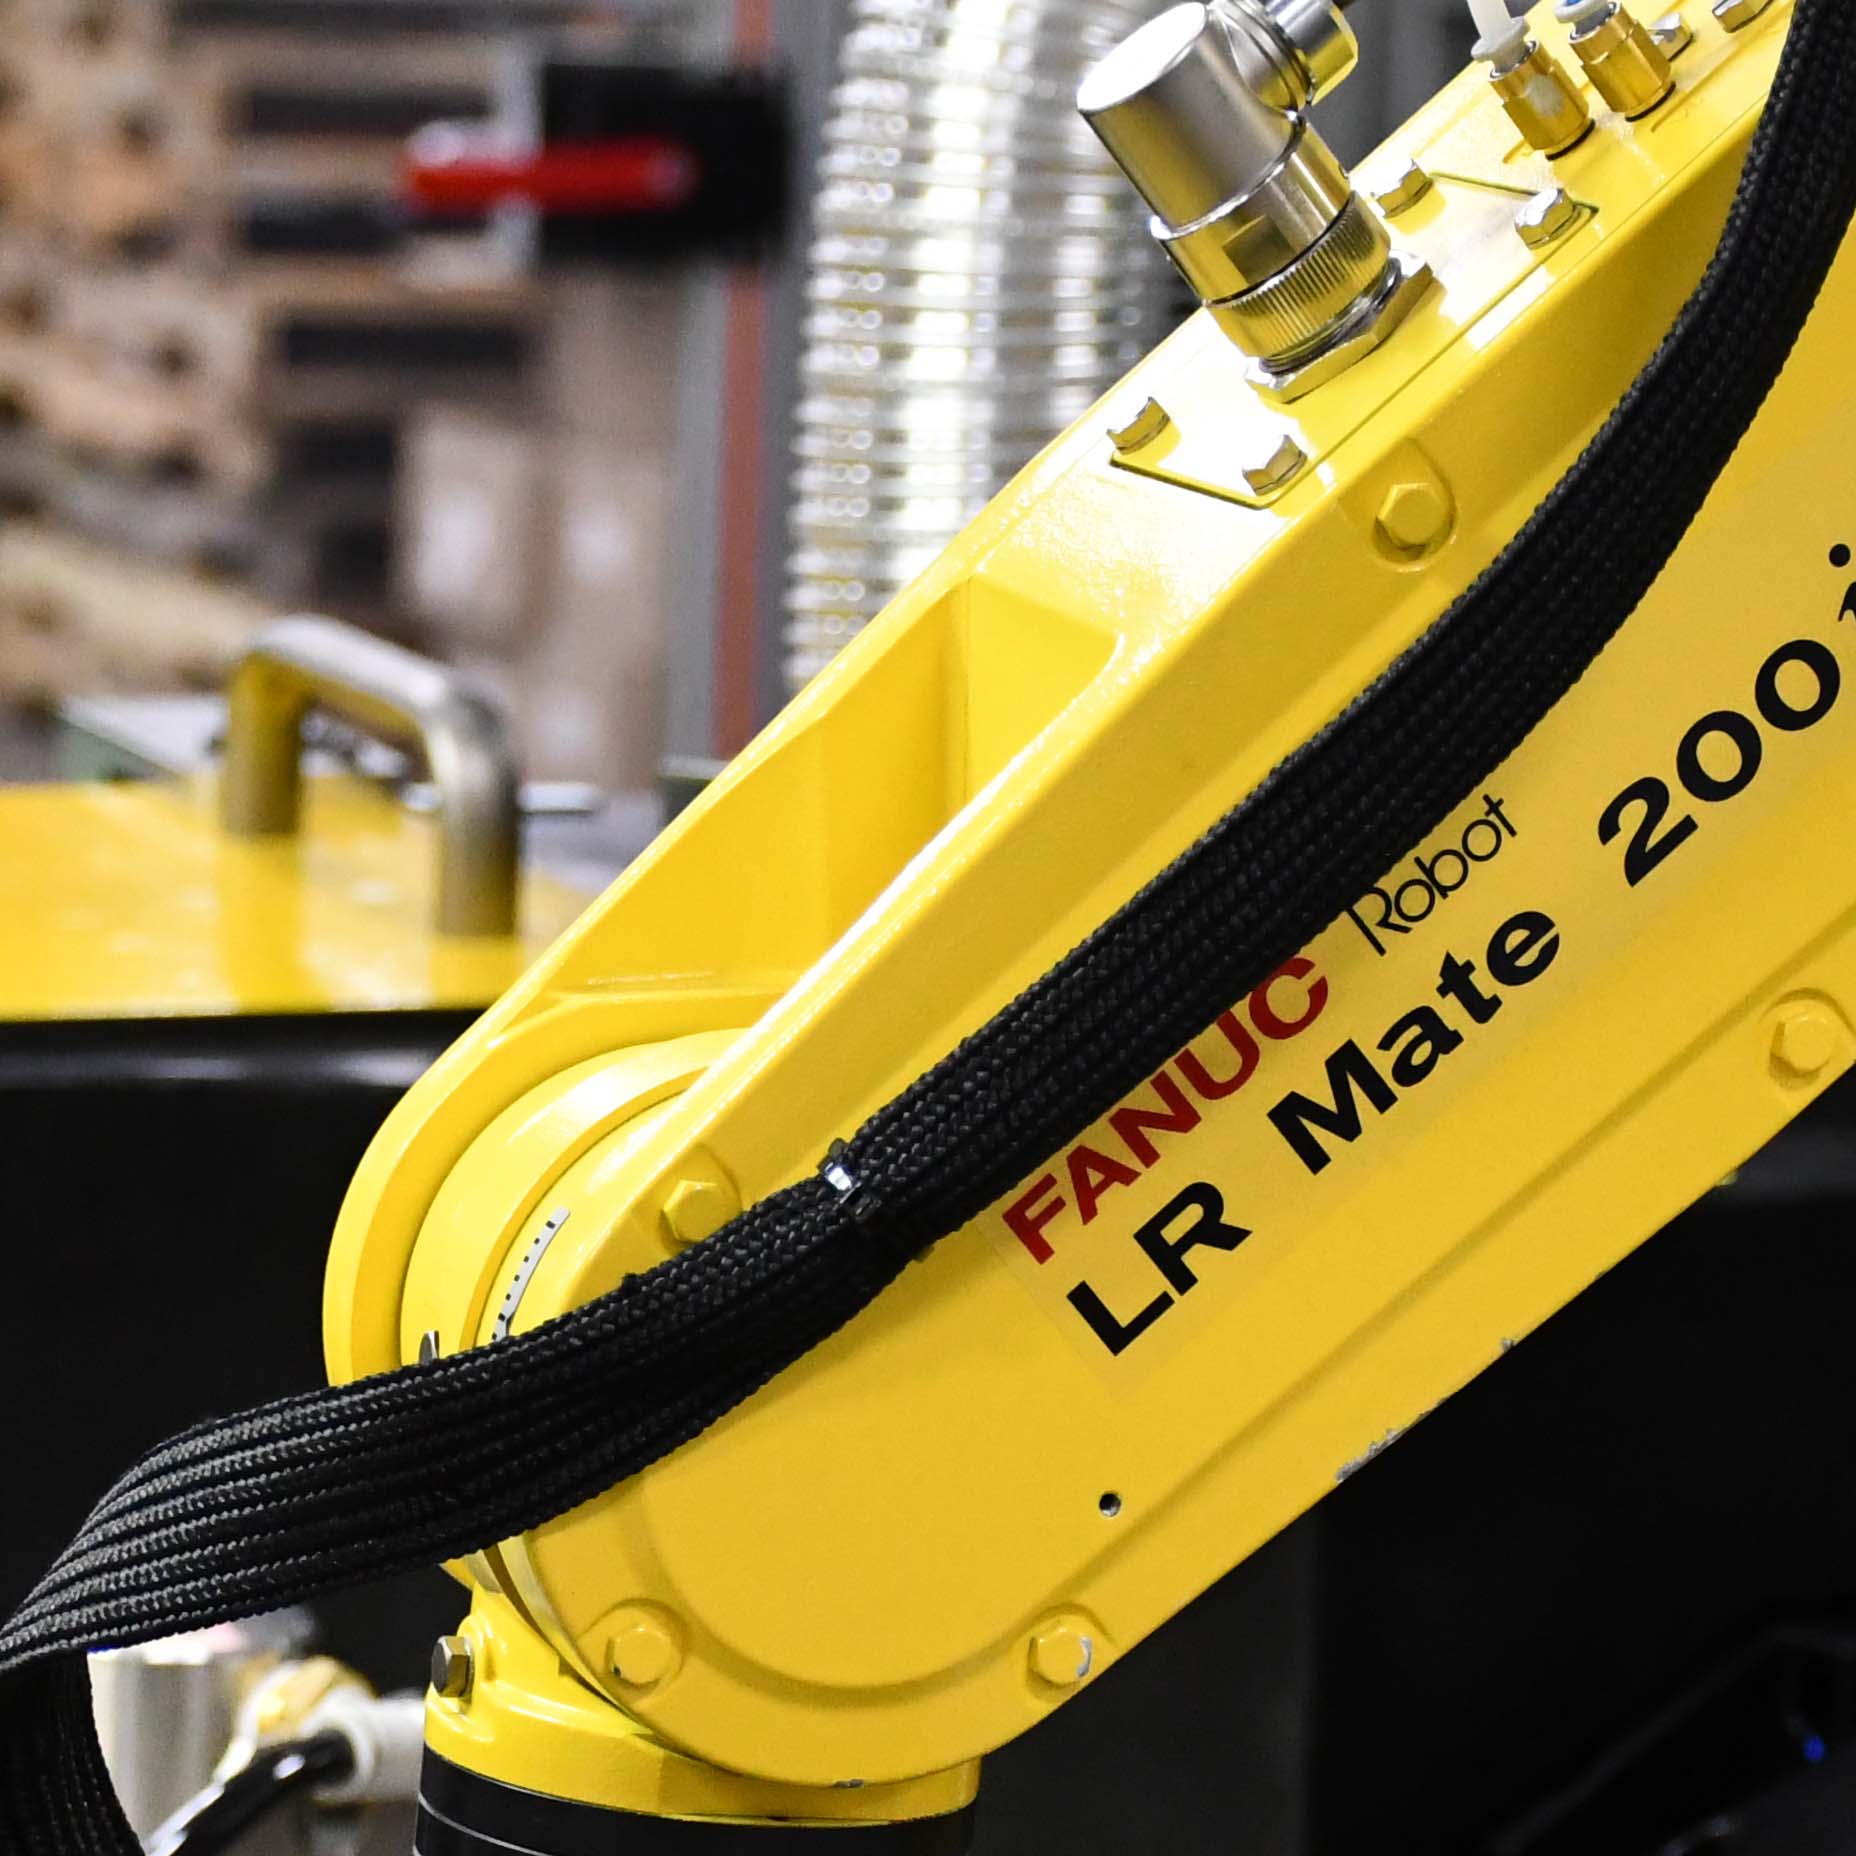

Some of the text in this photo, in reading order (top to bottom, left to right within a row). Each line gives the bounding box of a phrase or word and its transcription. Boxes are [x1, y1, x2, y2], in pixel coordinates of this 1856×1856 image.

[1002, 795, 1518, 1264] FANUC Robot
[1065, 1179, 1252, 1357] LR
[1265, 908, 1562, 1175] Mate
